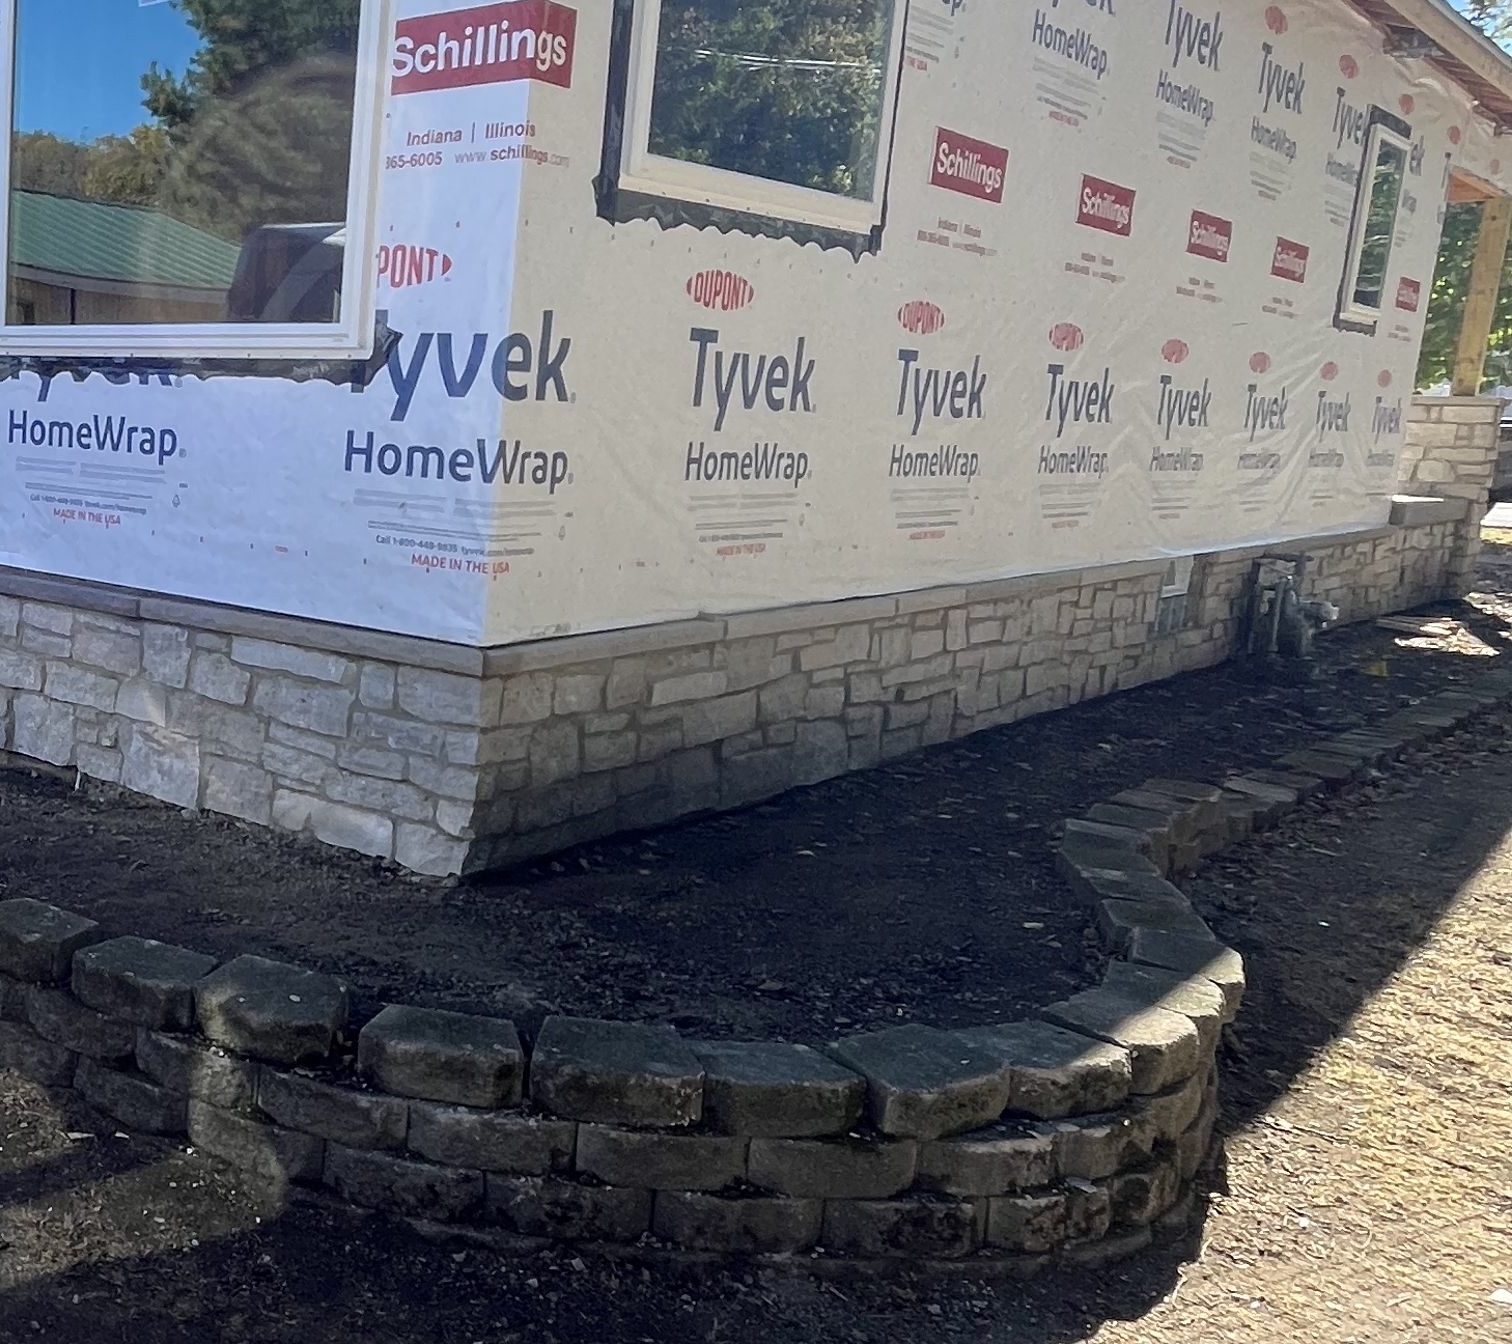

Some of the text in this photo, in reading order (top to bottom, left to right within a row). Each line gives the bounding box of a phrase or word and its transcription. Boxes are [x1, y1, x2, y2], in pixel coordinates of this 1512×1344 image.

[392, 20, 567, 77] Schillings
[1032, 9, 1108, 80] HomeWrap
[1155, 68, 1214, 127] HomeWrap
[1258, 42, 1305, 114] Tyvek
[407, 128, 463, 147] Indiana
[485, 120, 536, 140] Illinois
[936, 142, 1003, 194] Schillings
[376, 244, 439, 288] PONT
[689, 327, 815, 432] Tyvek
[896, 349, 986, 436] Tyvek
[1045, 363, 1115, 438] Tyvek
[1157, 375, 1212, 440] Tyvek
[8, 410, 177, 465] HomeWrap
[1244, 384, 1288, 442] Tyvek
[345, 430, 568, 494] HomeWrap
[685, 442, 809, 488] HomeWrap
[889, 444, 979, 483] HomeWrap
[1038, 445, 1109, 479] HomeWrap
[53, 507, 121, 525] MADE IN THE USA
[412, 554, 510, 574] MADE IN THE USA
